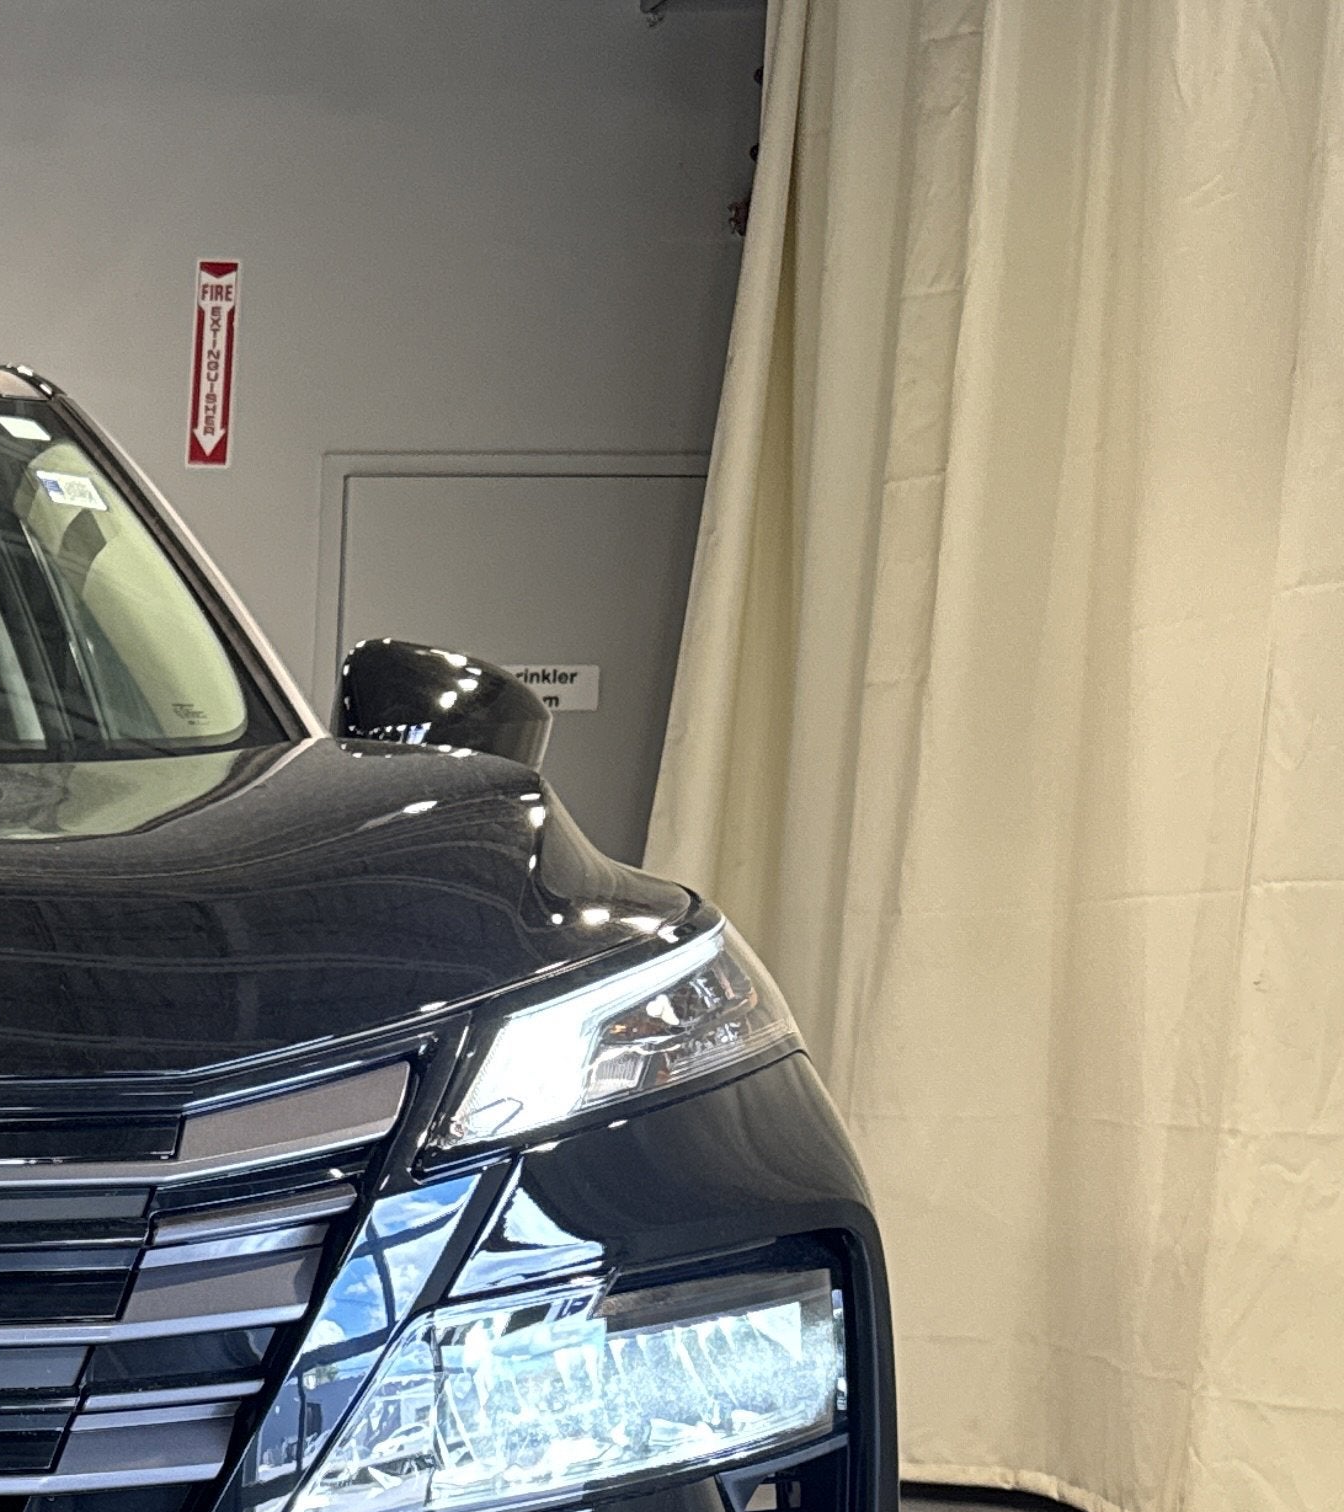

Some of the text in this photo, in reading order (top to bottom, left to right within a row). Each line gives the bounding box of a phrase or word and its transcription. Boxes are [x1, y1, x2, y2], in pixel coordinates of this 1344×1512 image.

[201, 284, 233, 302] FIRE
[202, 306, 222, 436] EXTINGUISHER
[515, 668, 578, 685] rinkler
